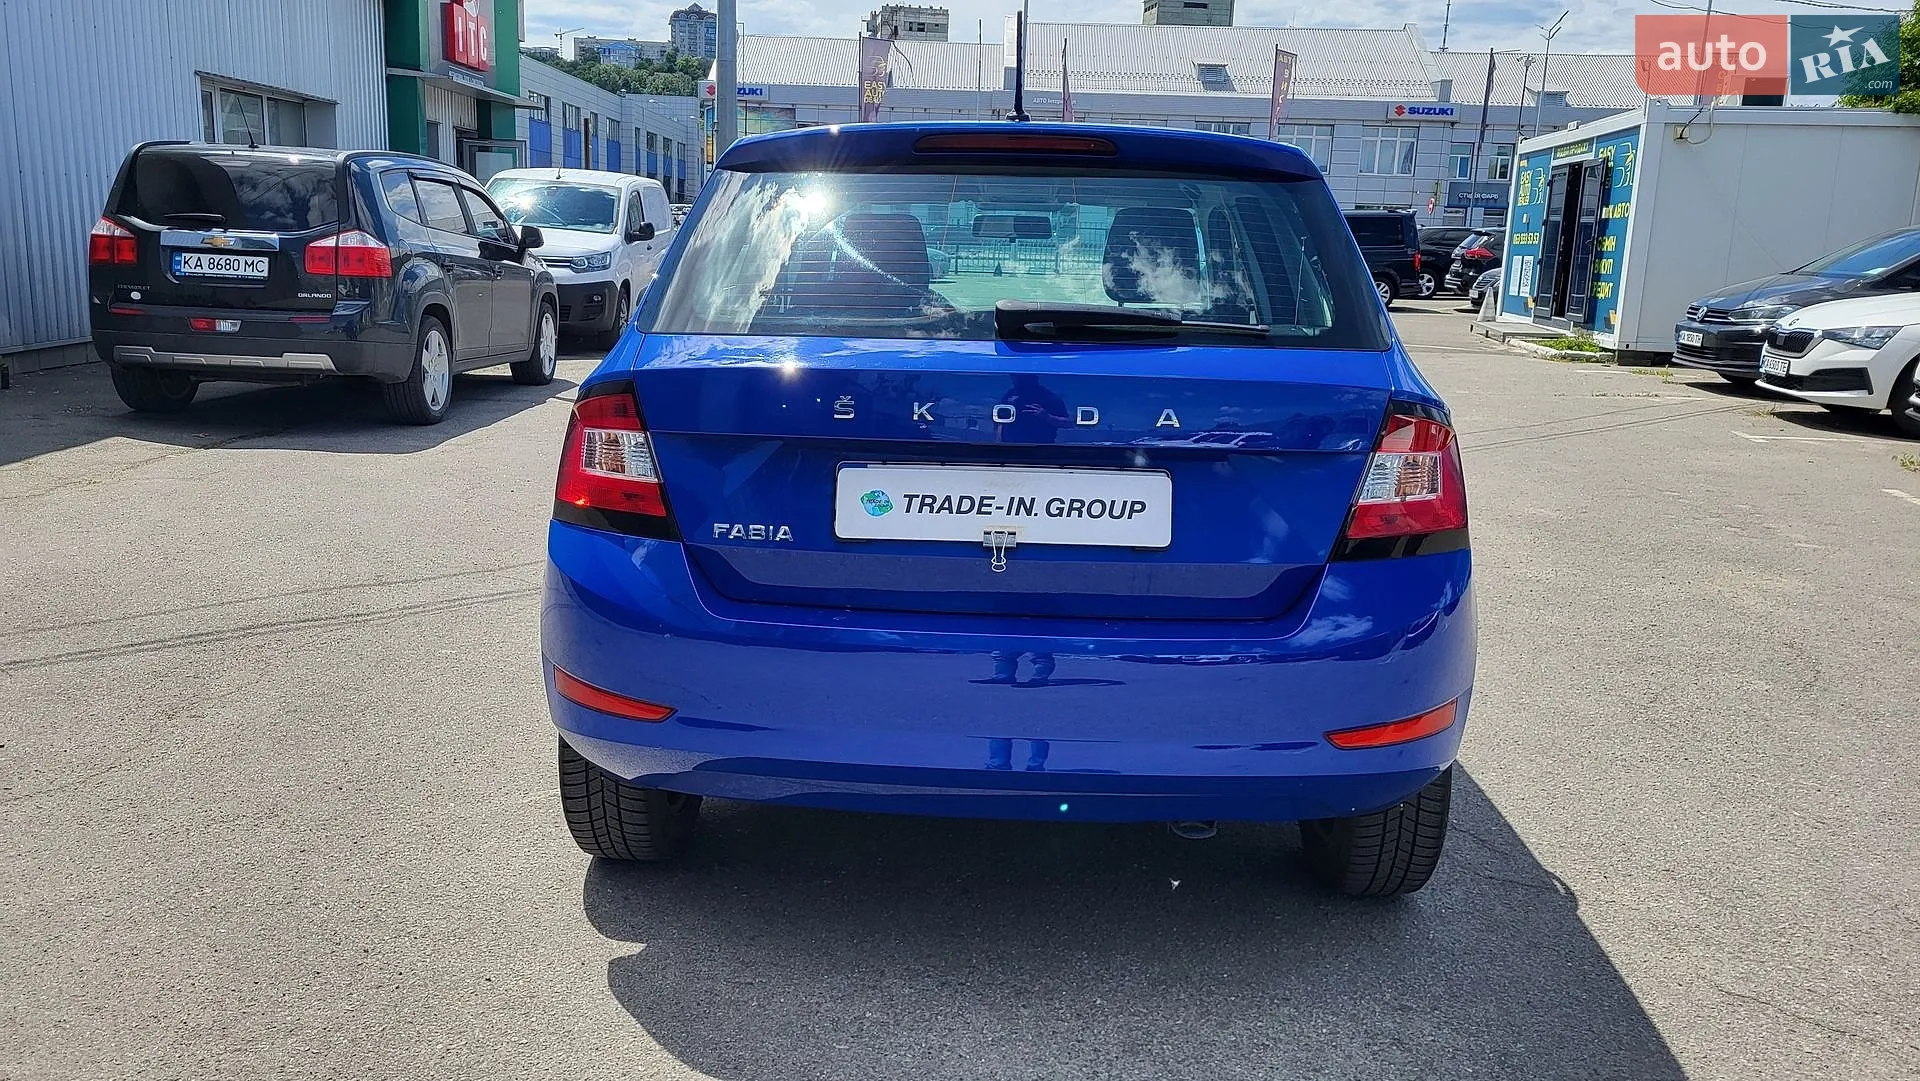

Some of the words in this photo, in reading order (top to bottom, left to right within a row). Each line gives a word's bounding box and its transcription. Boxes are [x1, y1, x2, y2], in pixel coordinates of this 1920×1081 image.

[737, 87, 763, 96] ZUKI
[864, 89, 886, 98] AUT
[1407, 106, 1454, 116] SUZUKI
[183, 256, 204, 270] KA
[207, 256, 240, 271] 8680
[244, 259, 265, 273] MC
[832, 395, 1182, 428] ŠKODA
[902, 494, 1039, 517] TRADE-IN.
[1039, 497, 1148, 520] GROUP
[713, 523, 794, 543] FABIA
